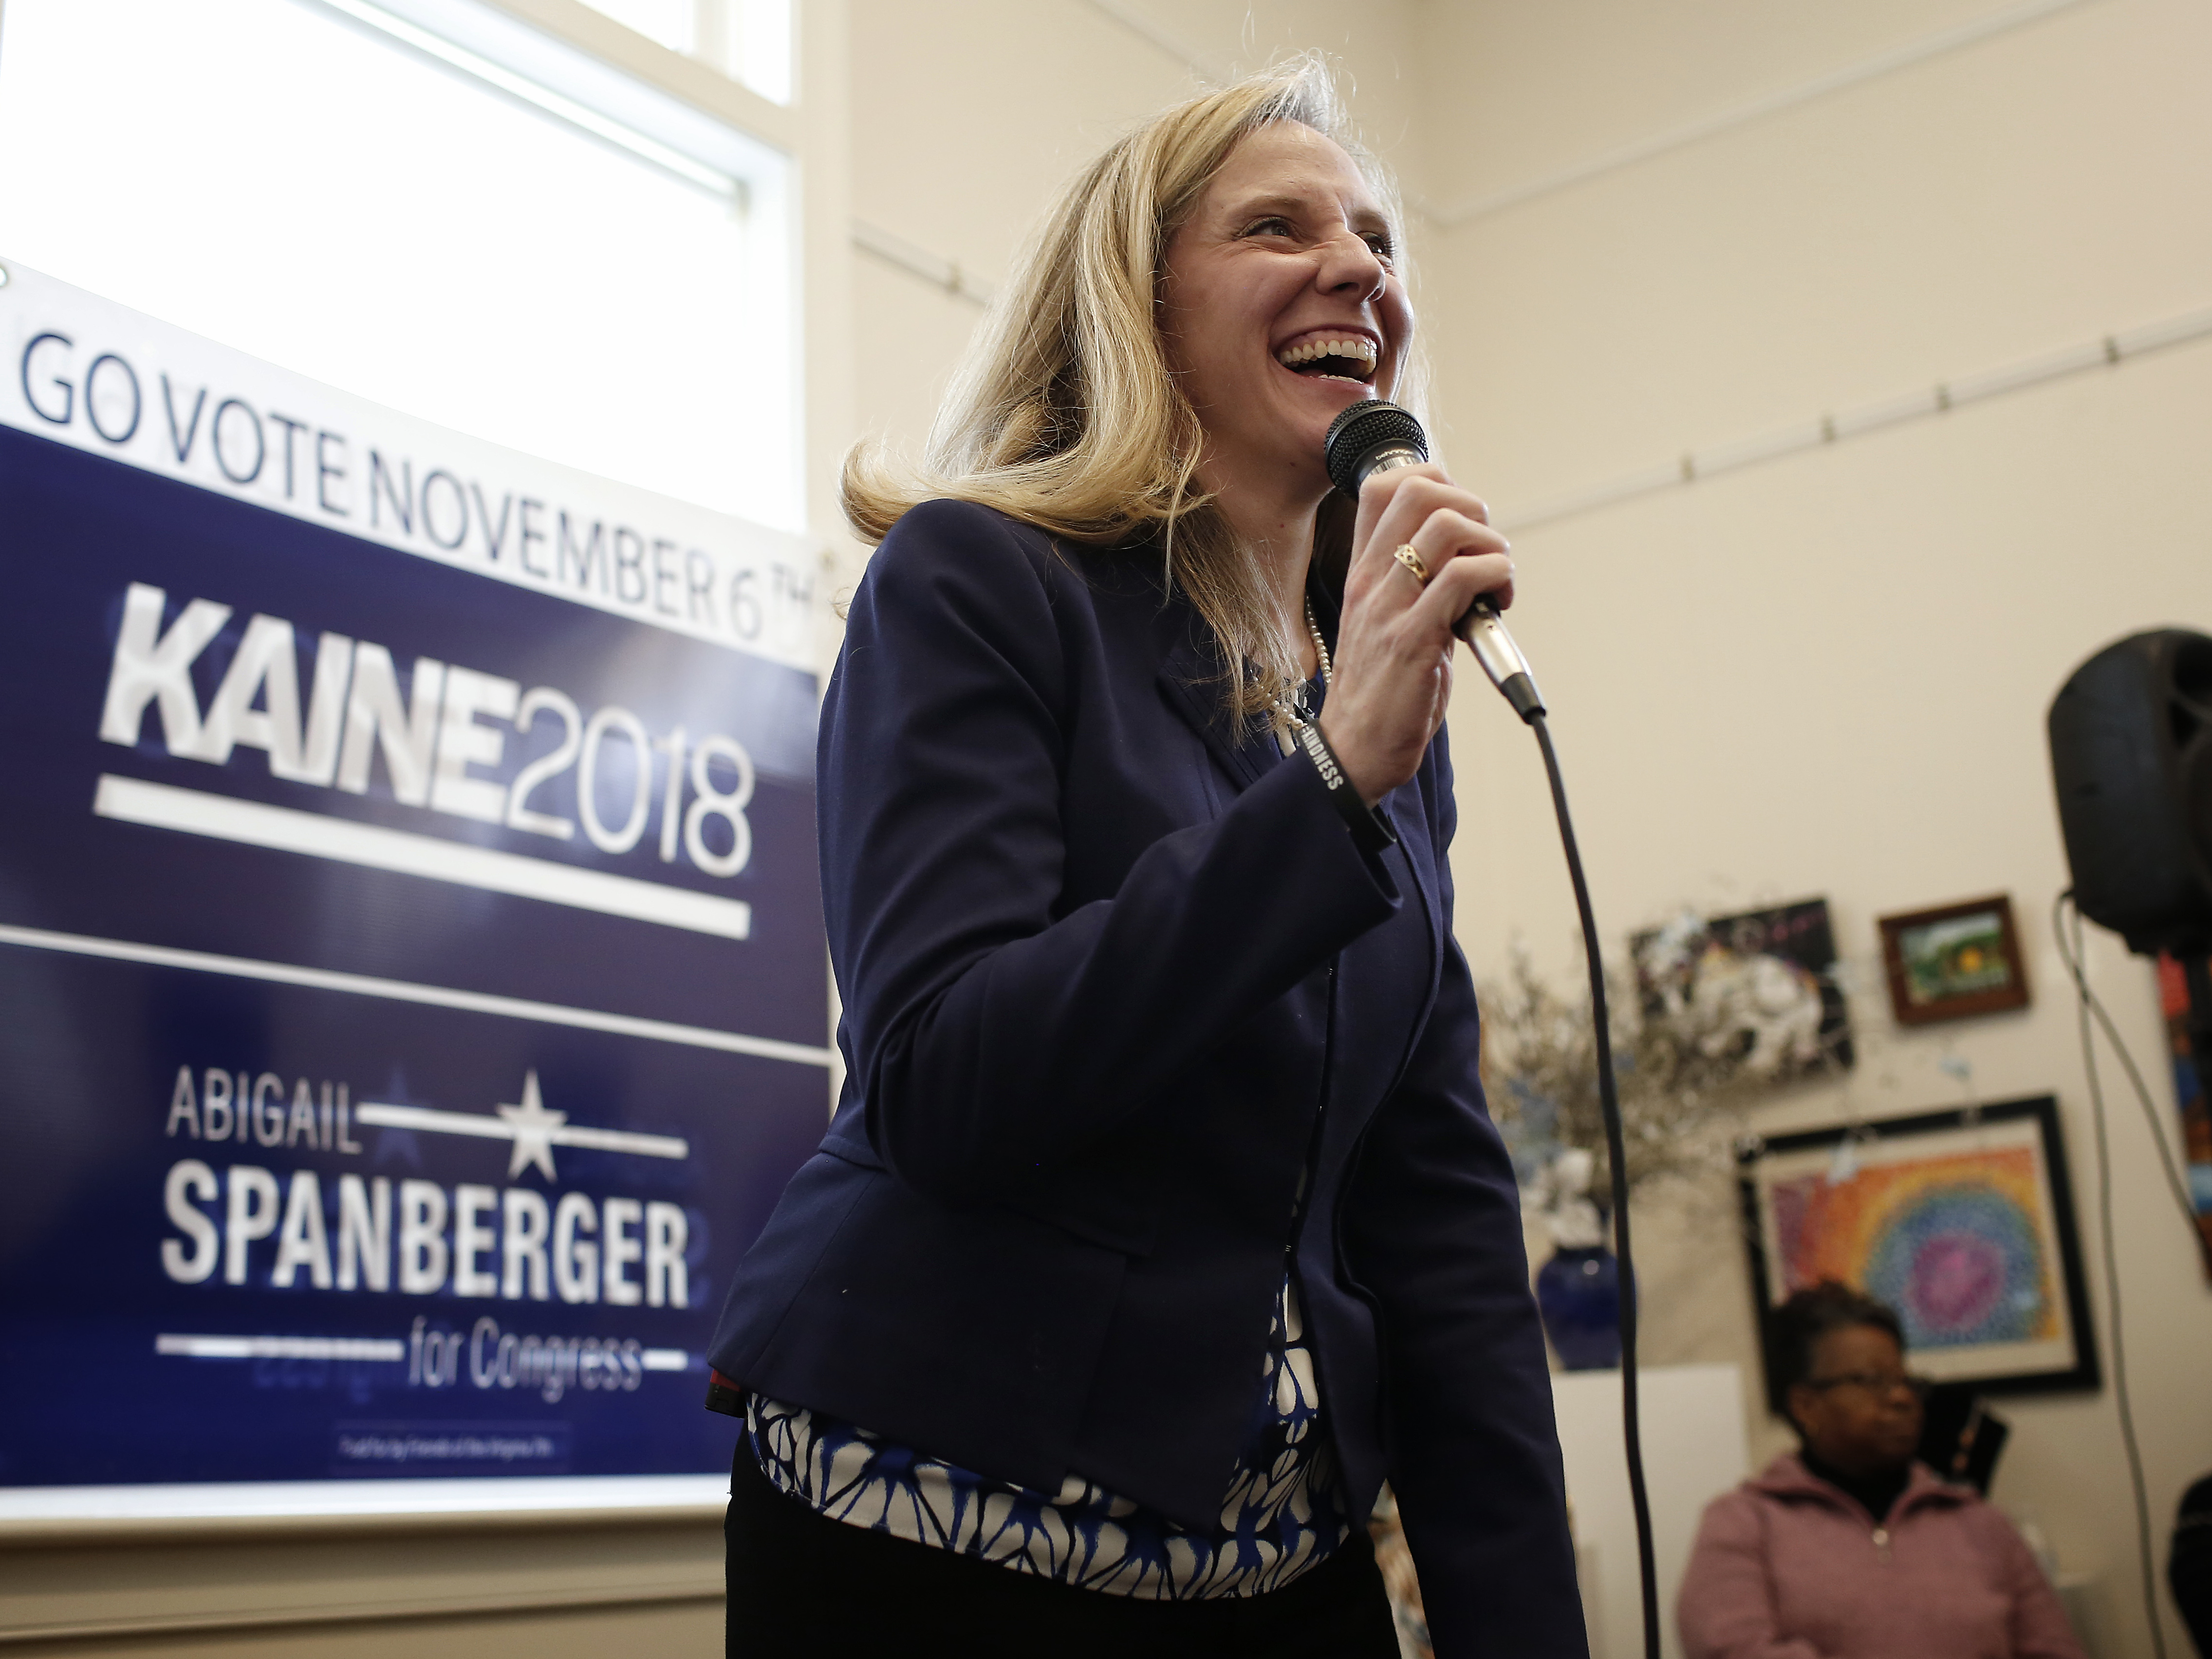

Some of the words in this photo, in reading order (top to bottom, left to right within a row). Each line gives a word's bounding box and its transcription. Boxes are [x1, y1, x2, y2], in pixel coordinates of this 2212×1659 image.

[20, 330, 141, 444] GO
[160, 371, 351, 518] VOTE
[369, 447, 718, 628] NOVEMBER
[166, 1064, 362, 1155] ABIGAIL
[161, 1158, 690, 1309] SPANBERGER
[408, 1315, 465, 1388] for
[469, 1315, 643, 1403] Congress
